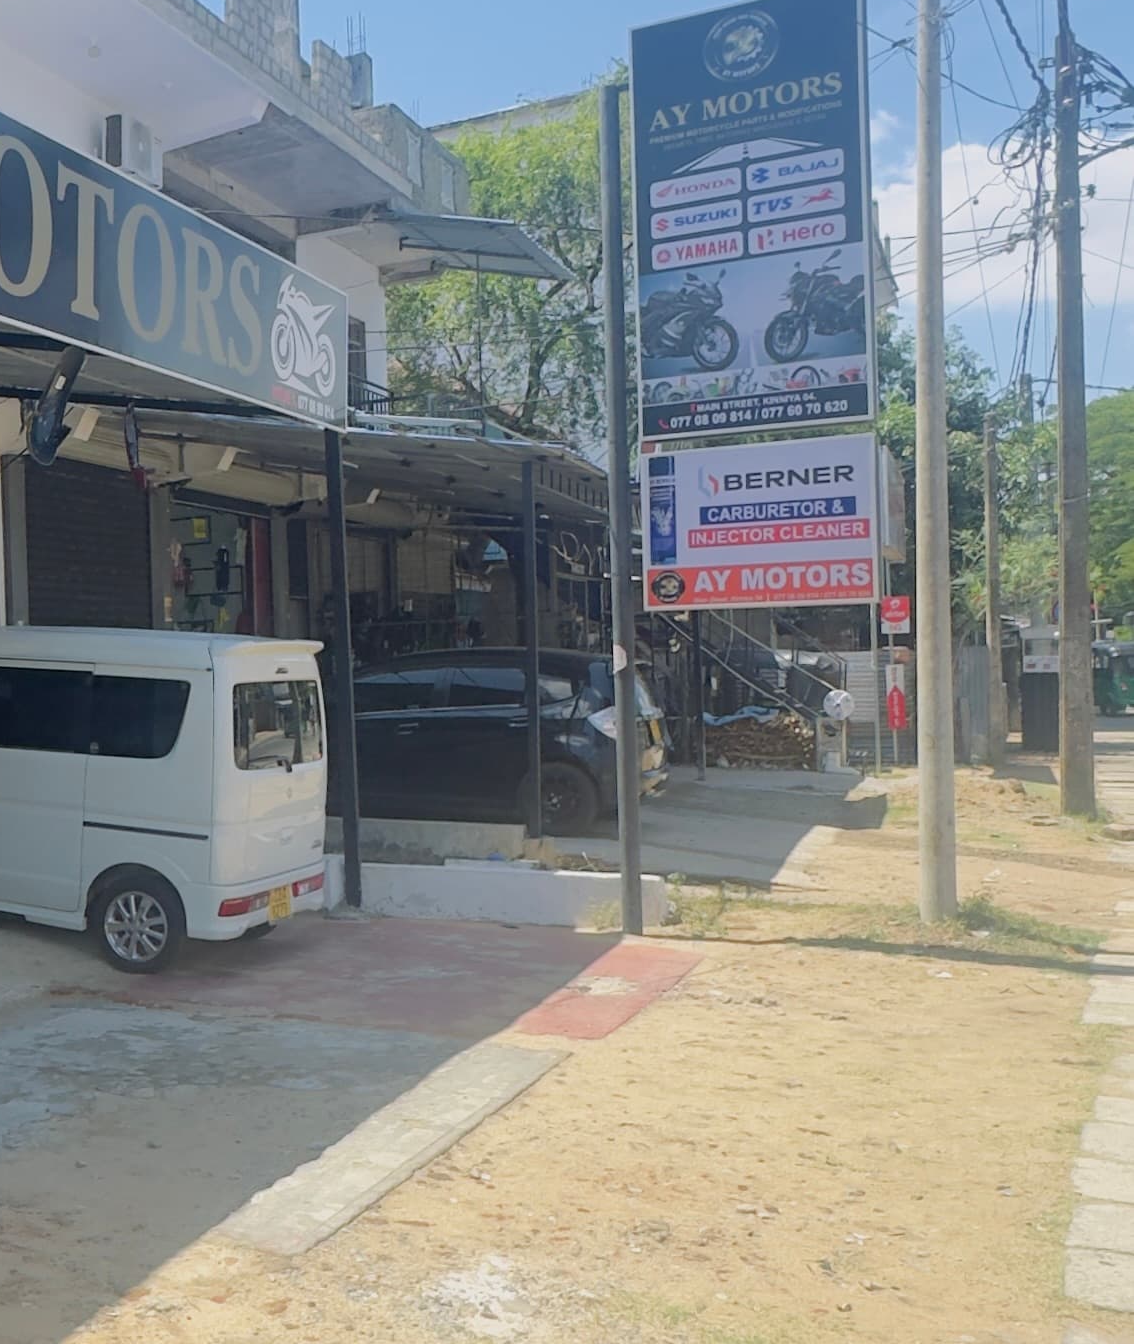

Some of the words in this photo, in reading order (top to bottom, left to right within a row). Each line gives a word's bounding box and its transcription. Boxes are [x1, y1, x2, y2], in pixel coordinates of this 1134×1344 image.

[649, 103, 691, 133] AY
[702, 72, 843, 121] MOTORS
[778, 157, 839, 177] BAJAJ
[674, 177, 736, 196] HONDA
[673, 207, 737, 227] SUZUKI
[752, 196, 794, 215] TVS
[676, 238, 738, 261] YAMAHA
[670, 415, 692, 429] 077
[712, 411, 727, 424] 09
[729, 409, 751, 421] 814
[761, 406, 784, 419] 077
[787, 404, 802, 417] 60
[805, 402, 821, 415] 70
[824, 400, 848, 413] 620
[696, 400, 720, 413] MAIN
[723, 464, 855, 491] BERNER
[707, 501, 827, 523] CARBURETOR
[831, 499, 844, 514] &
[691, 528, 775, 545] INJECTOR
[779, 521, 865, 540] CLEANER
[694, 570, 731, 593] AY
[741, 563, 871, 590] MOTORS
